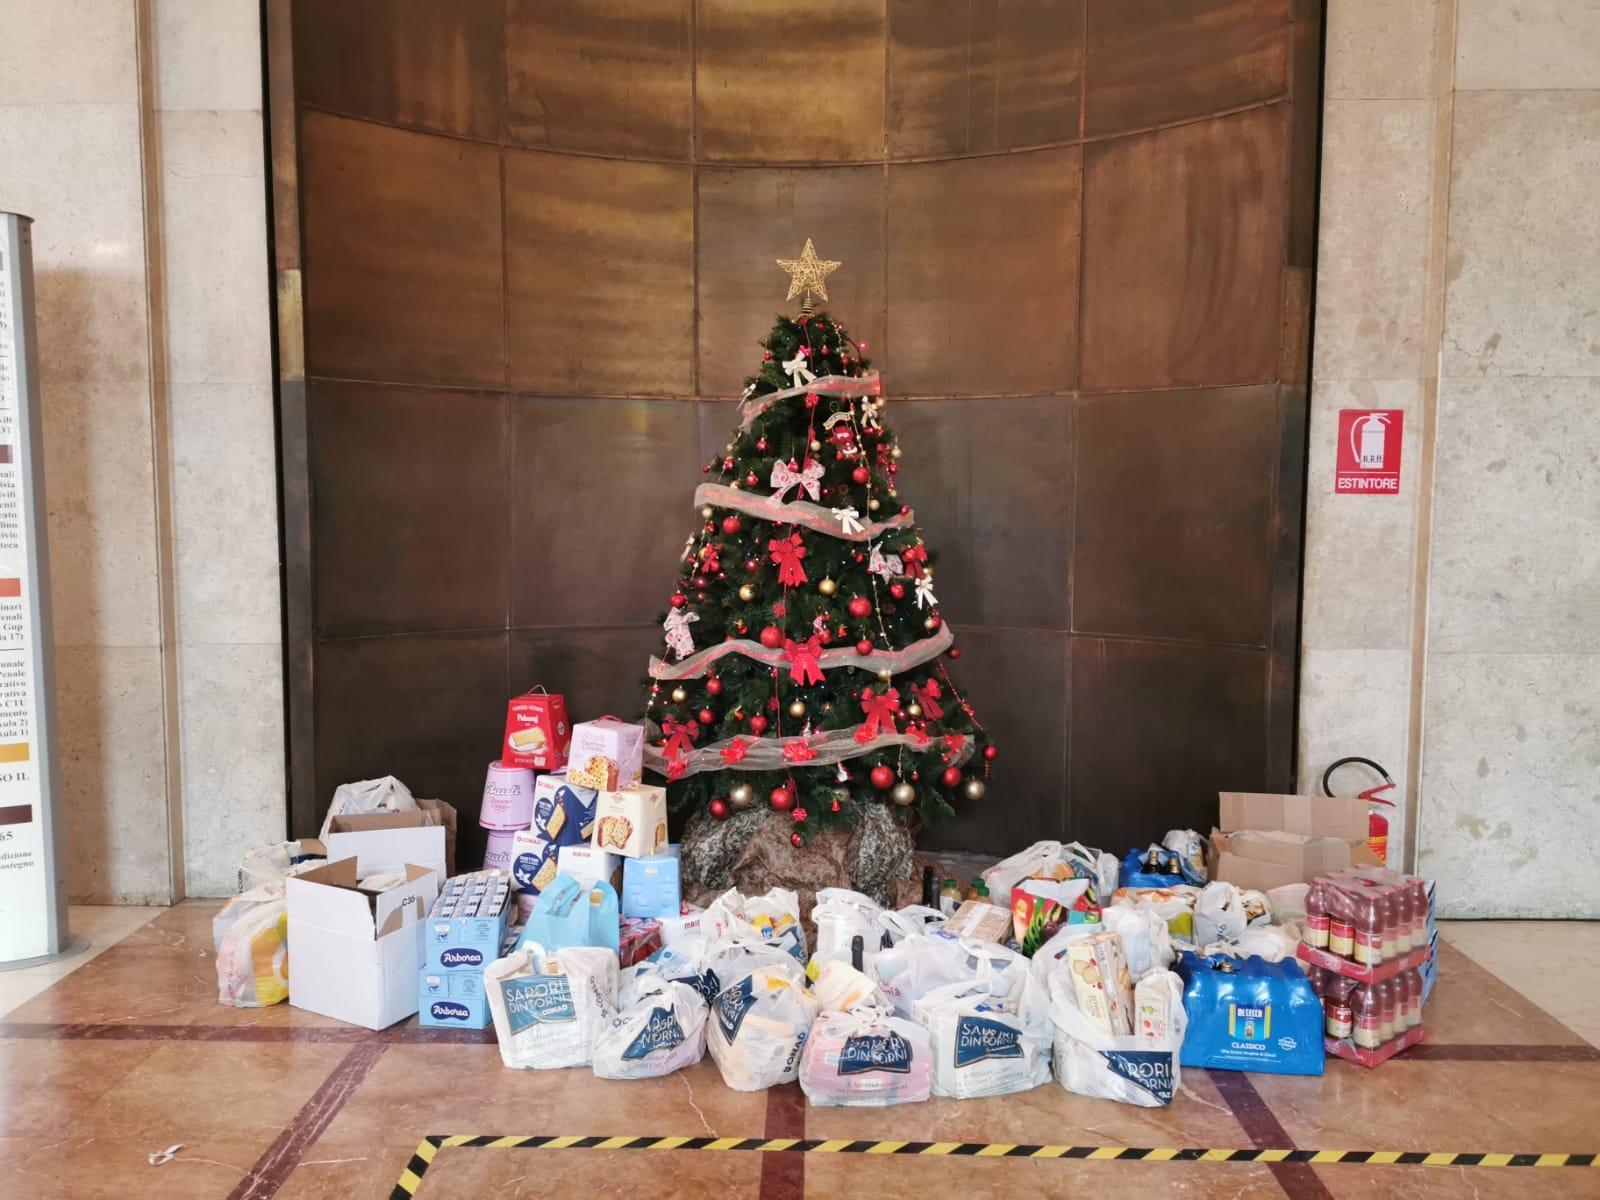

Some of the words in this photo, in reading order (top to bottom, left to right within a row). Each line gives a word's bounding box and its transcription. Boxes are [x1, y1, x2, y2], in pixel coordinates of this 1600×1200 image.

[1337, 477, 1398, 489] ESTINTORE
[0, 613, 23, 621] enali
[0, 851, 33, 861] dizione
[442, 952, 482, 963] Arborea
[433, 1005, 469, 1018] Arborea
[1231, 1042, 1266, 1051] CLASSICO
